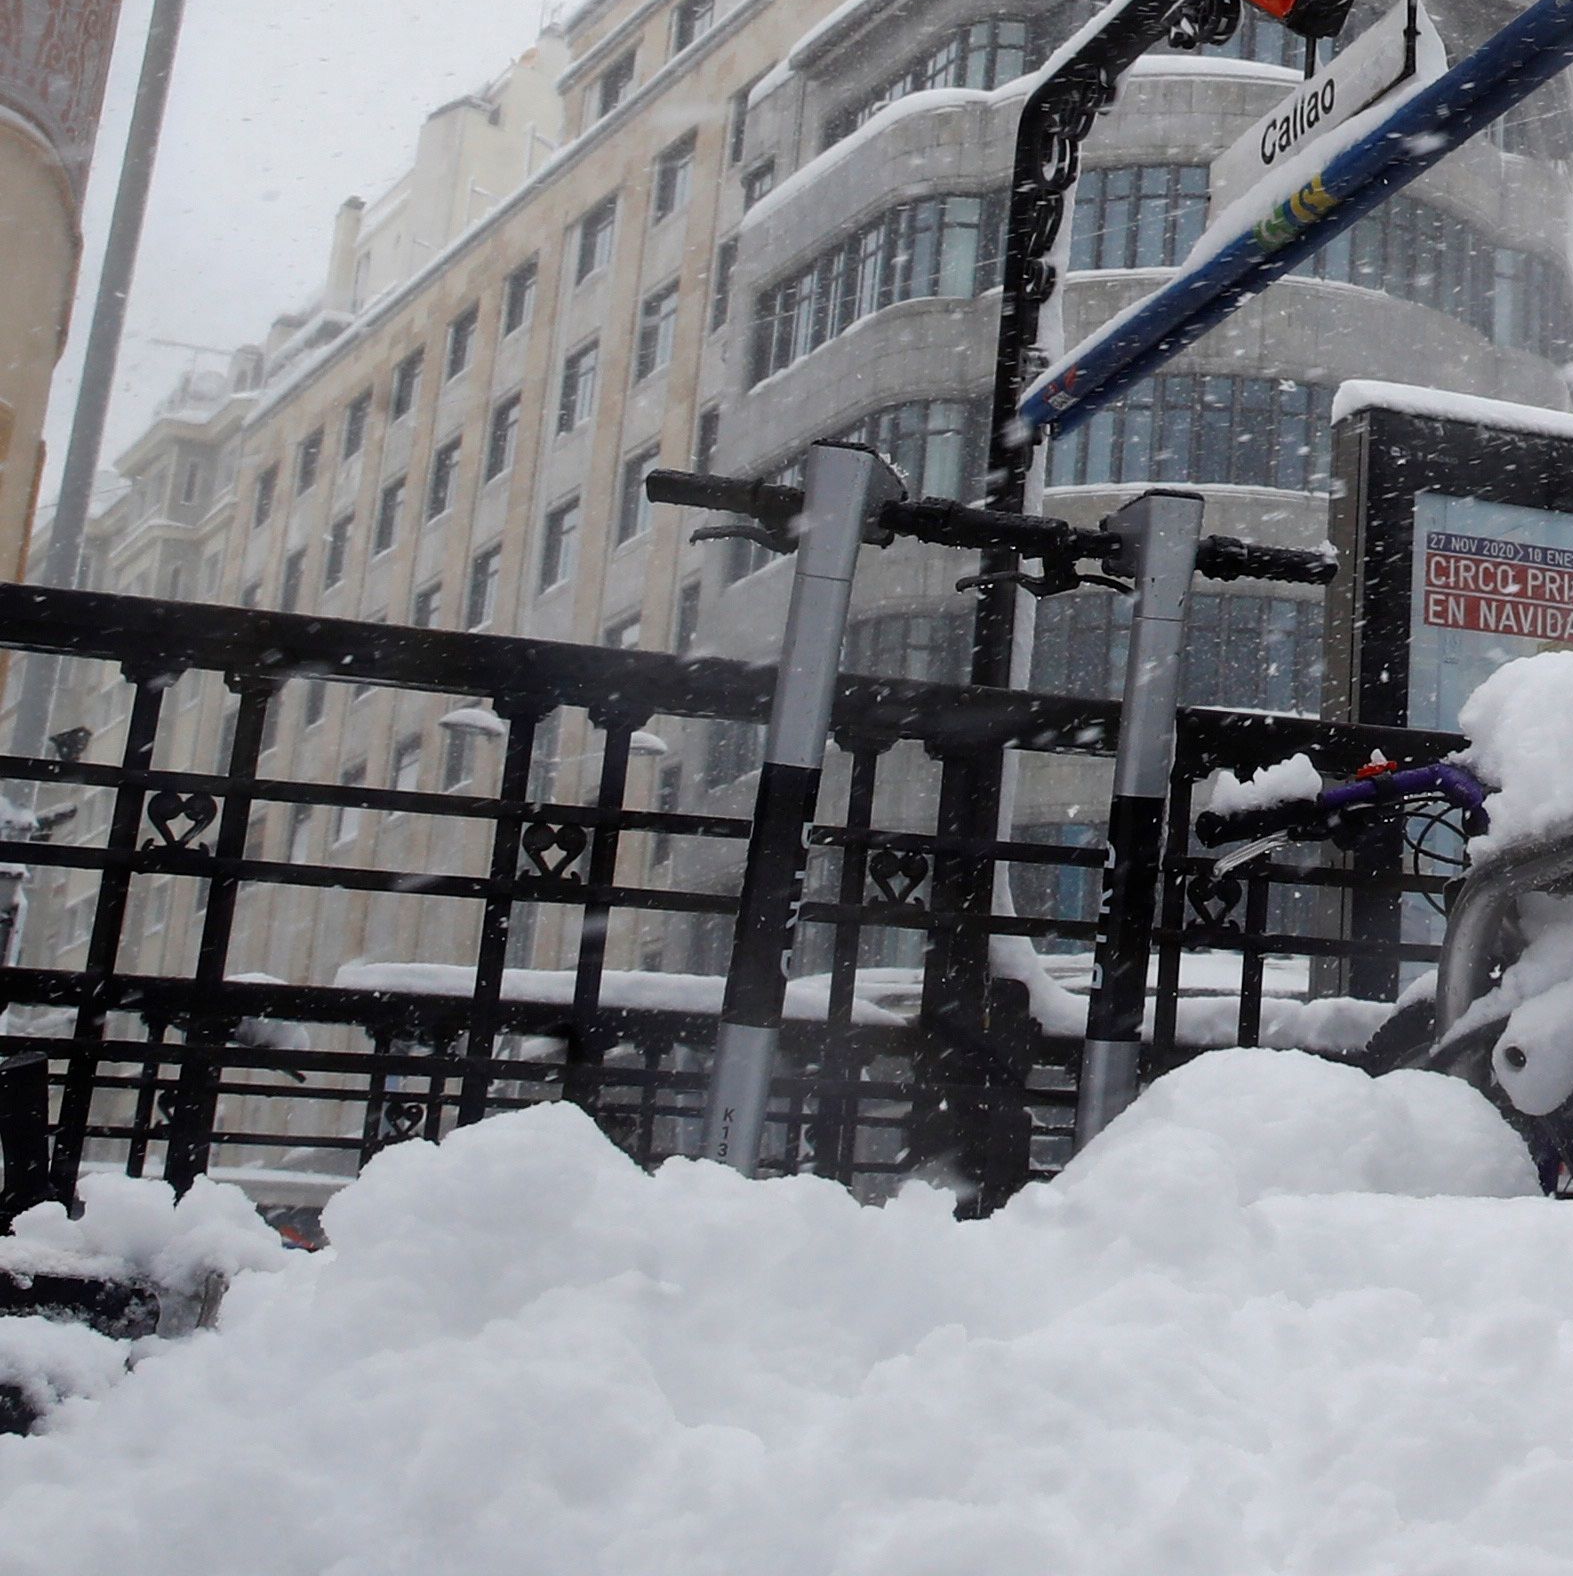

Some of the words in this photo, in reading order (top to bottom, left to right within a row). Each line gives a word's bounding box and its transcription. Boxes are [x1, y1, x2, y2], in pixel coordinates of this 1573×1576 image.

[1260, 79, 1336, 166] Callao
[1429, 533, 1447, 550] 27
[1449, 536, 1477, 555] NOV
[1482, 540, 1515, 559] 2020
[1527, 546, 1542, 564] 10
[1546, 548, 1573, 567] ENE
[1429, 555, 1515, 593] CIRCO
[1428, 593, 1466, 627] EN
